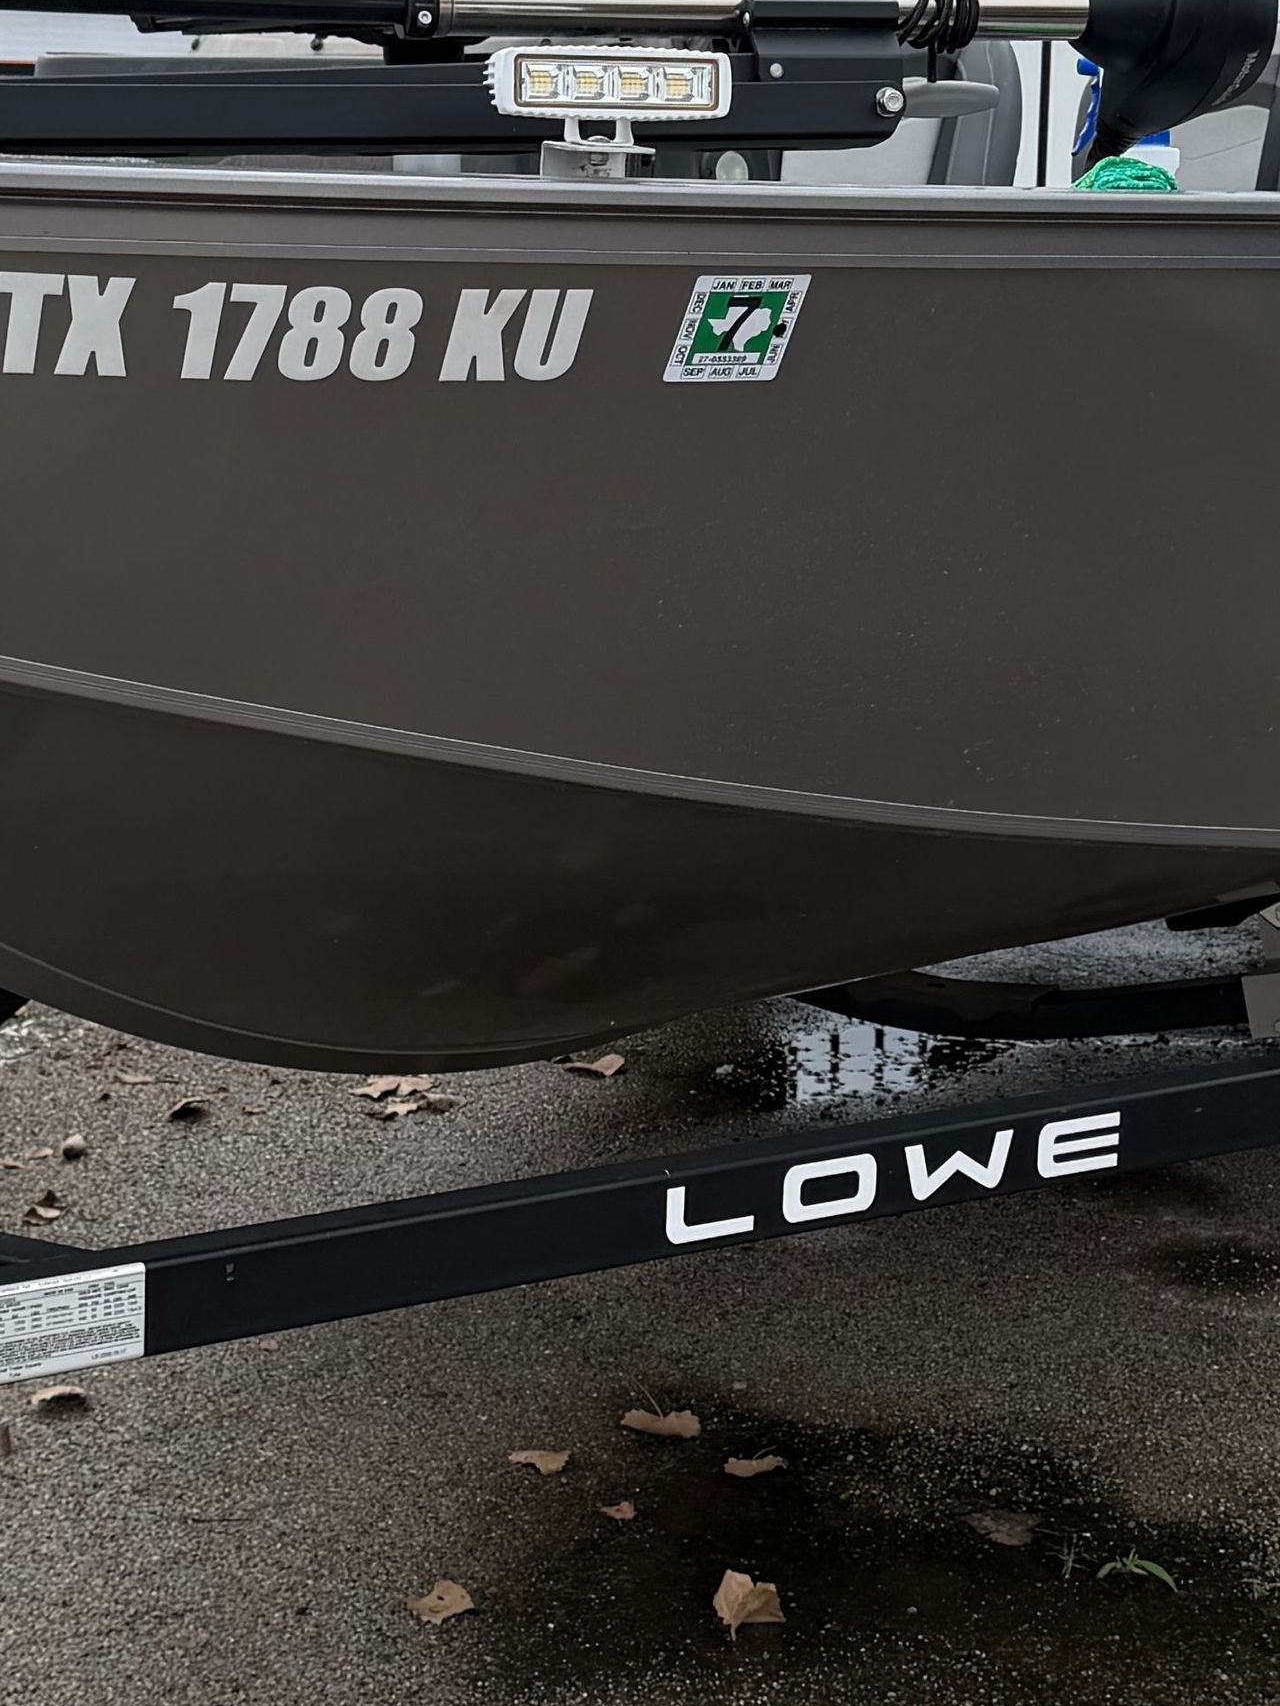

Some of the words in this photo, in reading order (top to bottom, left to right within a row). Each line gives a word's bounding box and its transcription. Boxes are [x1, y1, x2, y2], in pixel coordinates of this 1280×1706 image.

[712, 280, 735, 291] JAN
[740, 279, 764, 291] FEB
[768, 279, 793, 290] MAR
[692, 293, 706, 314] DEC
[784, 292, 800, 313] APR
[172, 281, 421, 382] 1788
[438, 288, 594, 382] KU
[683, 319, 697, 340] NOV
[717, 296, 763, 352] 7
[674, 345, 688, 365] OCT
[767, 344, 781, 364] JUN
[682, 367, 704, 377] SEP
[709, 367, 733, 377] AUG
[738, 366, 759, 376] JUL
[666, 1111, 1121, 1245] LOWE
